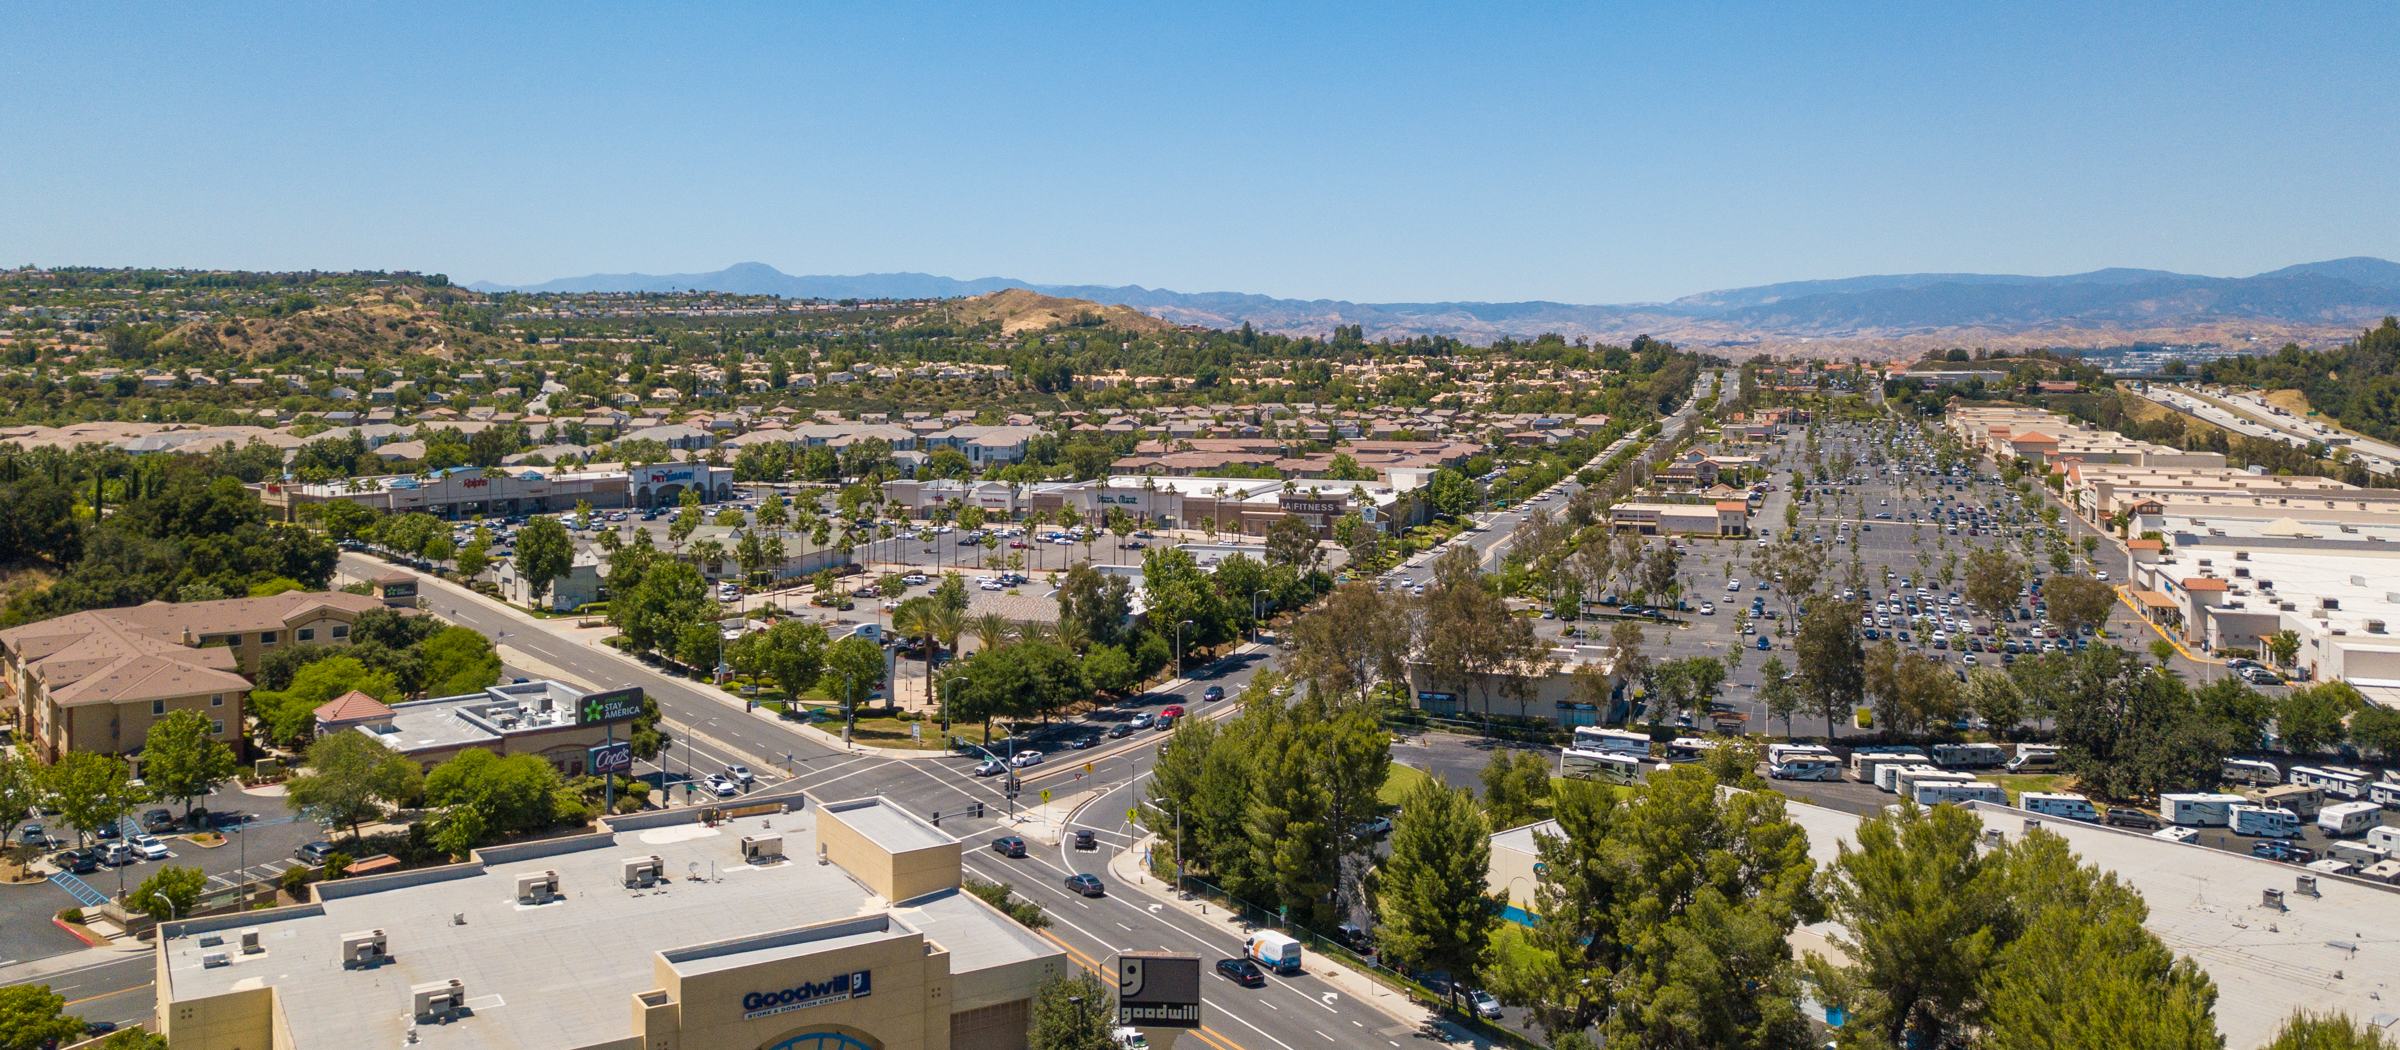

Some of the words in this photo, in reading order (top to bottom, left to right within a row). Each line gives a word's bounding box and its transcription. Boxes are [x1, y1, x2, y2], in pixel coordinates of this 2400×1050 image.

[463, 478, 488, 489] Ralphs
[1119, 494, 1138, 504] Mart
[1281, 502, 1291, 510] LA
[1294, 503, 1334, 511] FITNESS
[605, 701, 622, 712] STAY
[605, 706, 640, 719] AMERICA
[596, 747, 629, 772] Coco's
[743, 974, 850, 1011] Goodwill
[747, 1009, 772, 1019] STORE
[781, 1001, 817, 1012] DONATION
[819, 994, 847, 1005] CENTER
[1121, 1004, 1199, 1024] goodwill
